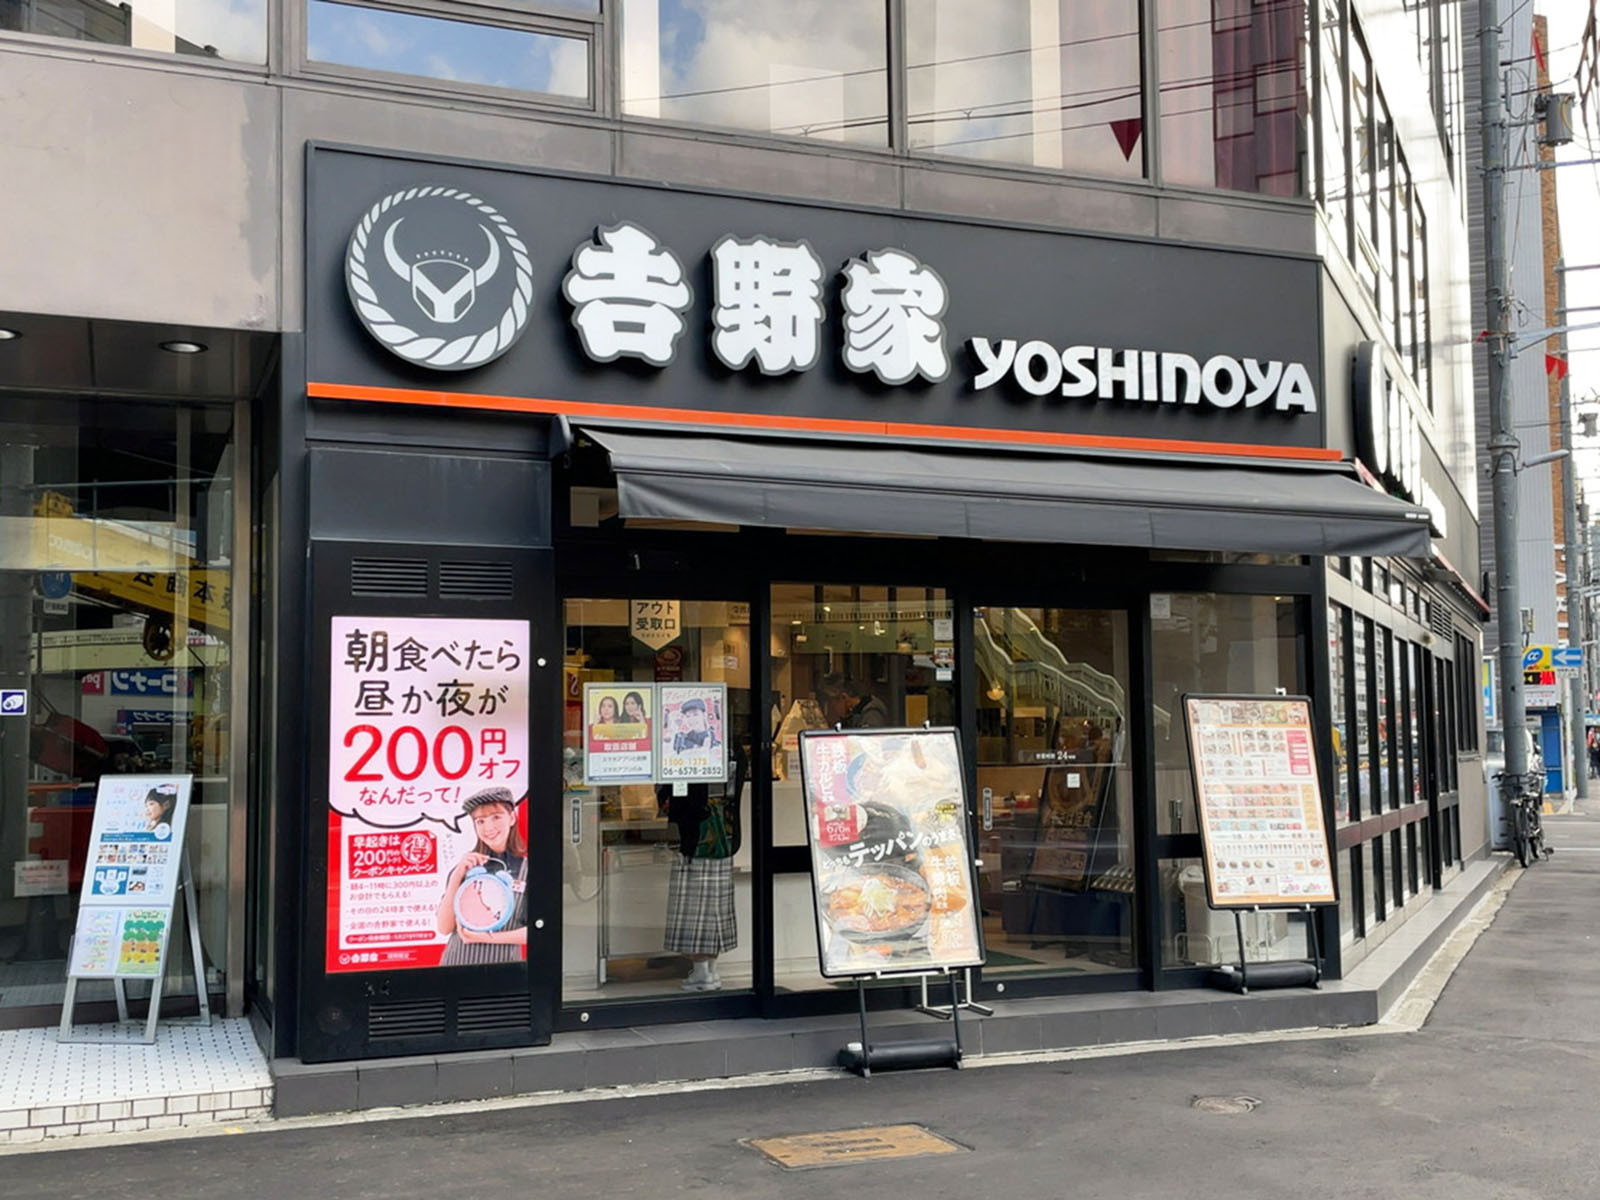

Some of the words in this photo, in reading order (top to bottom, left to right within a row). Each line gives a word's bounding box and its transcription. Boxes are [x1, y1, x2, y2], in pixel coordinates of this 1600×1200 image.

[563, 221, 950, 385] 吉野家
[970, 336, 1319, 413] YOSHINOYA
[636, 601, 674, 615] アウト
[635, 617, 676, 631] 受取口
[344, 628, 521, 673] 朝食べたら
[354, 679, 509, 717] 昼か夜が
[343, 725, 474, 782] 200
[480, 728, 507, 756] 円
[478, 758, 521, 780] オフ
[353, 834, 400, 849] 早起きは
[352, 863, 435, 878] クーポンキャンペーン
